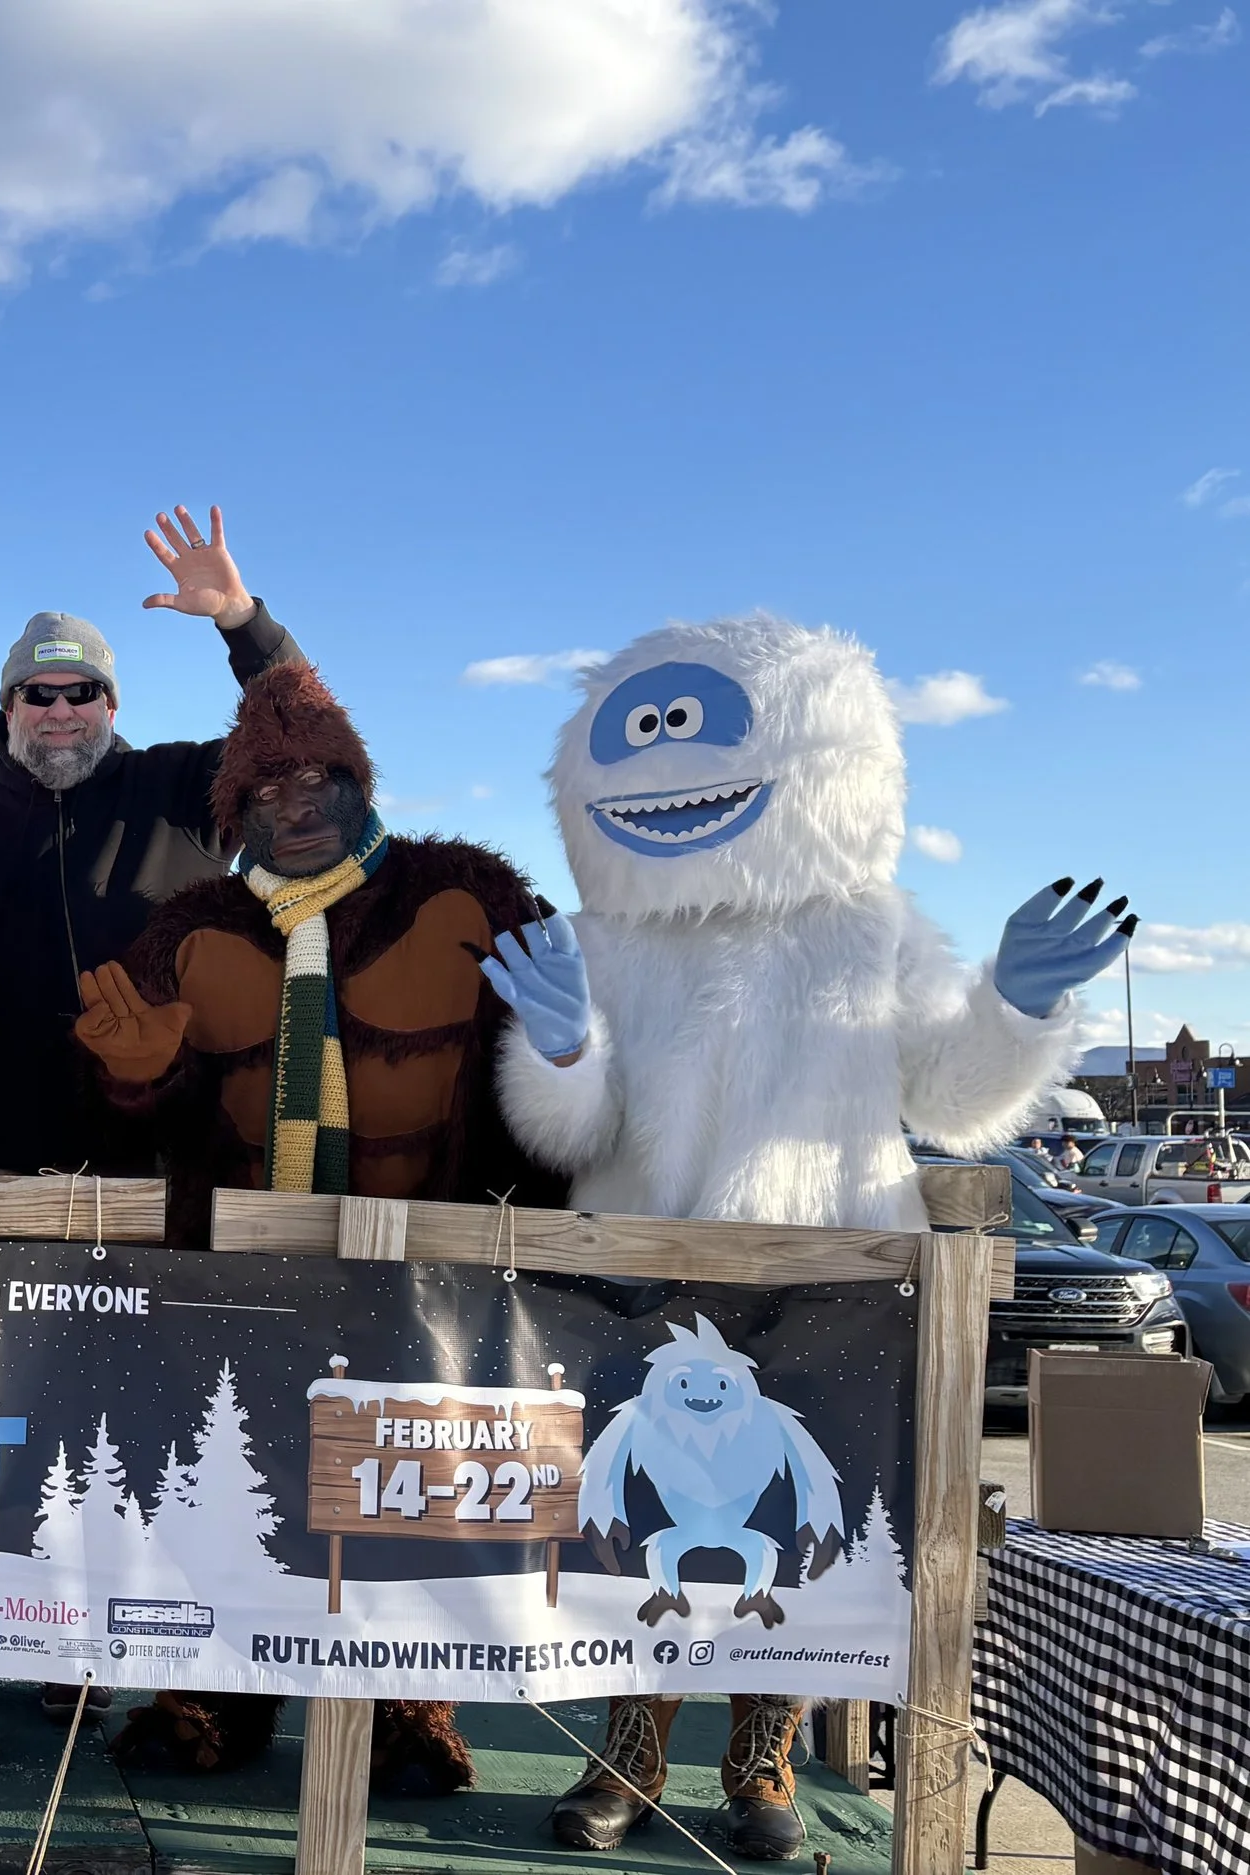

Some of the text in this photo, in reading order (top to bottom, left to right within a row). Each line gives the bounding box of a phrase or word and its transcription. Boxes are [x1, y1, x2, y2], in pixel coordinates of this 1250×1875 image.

[8, 1281, 150, 1315] EVERYONE
[376, 1417, 533, 1451] FEBRUARY
[114, 1603, 212, 1625] casella
[10, 1634, 45, 1648] Oliver
[111, 1626, 190, 1636] CONSTRUCTION
[129, 1645, 200, 1659] OTTER CREEK LAW
[251, 1634, 634, 1672] RUTLANDWINTERFEST.COM
[729, 1645, 891, 1669] @rutlandwinterfest
